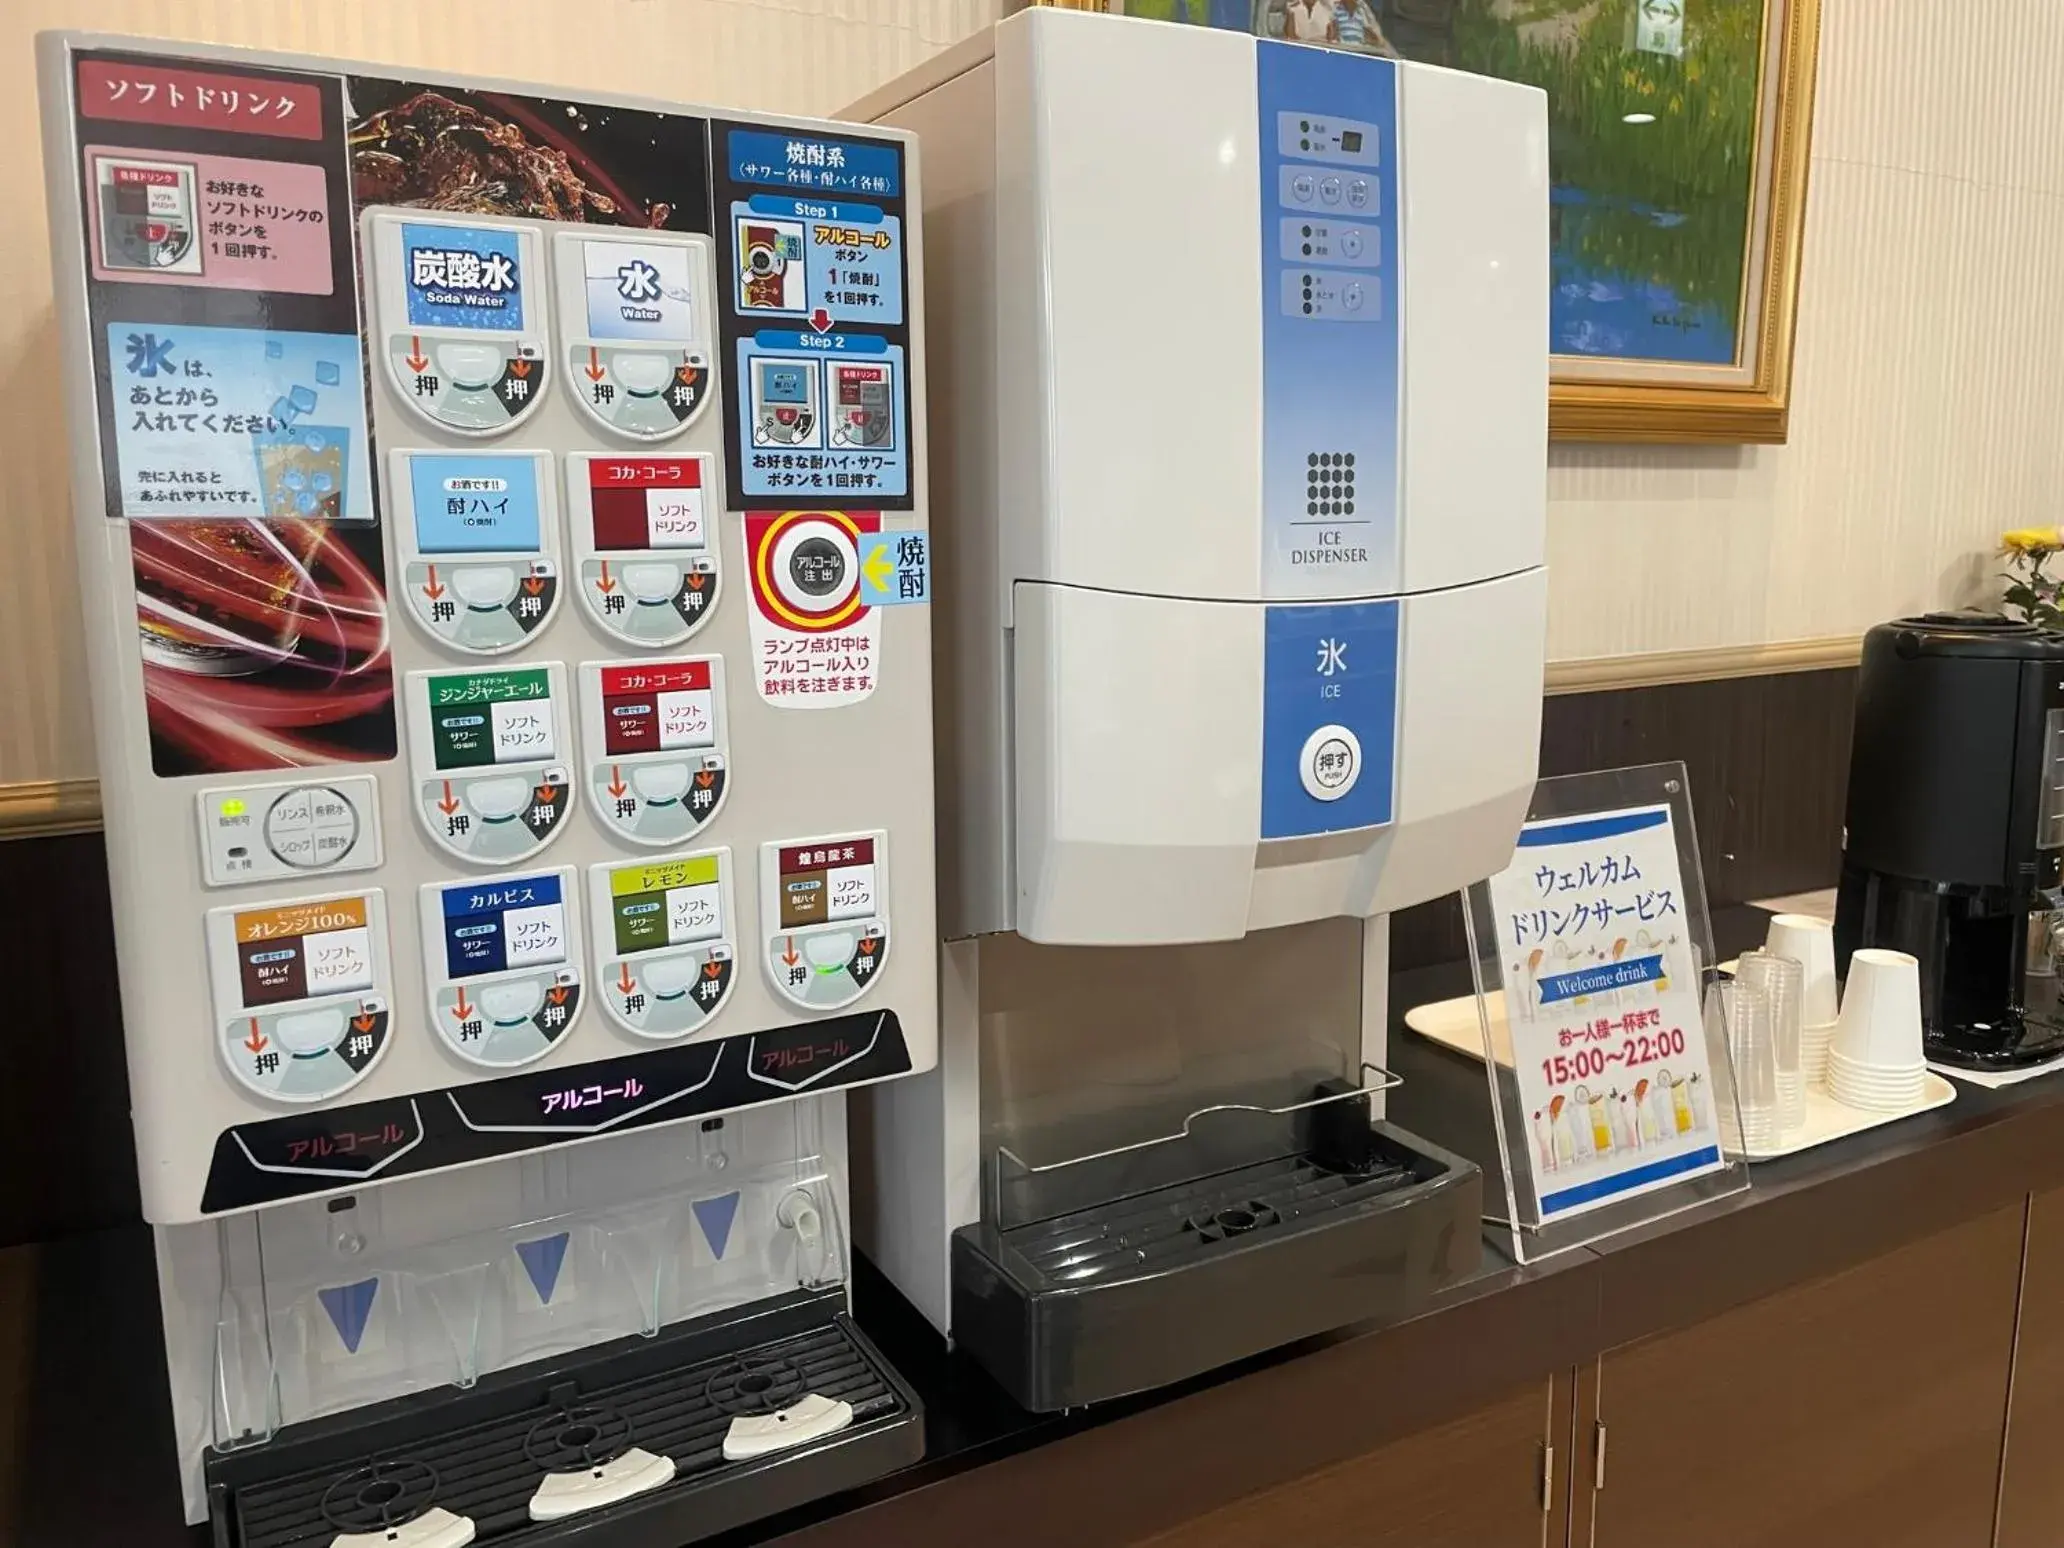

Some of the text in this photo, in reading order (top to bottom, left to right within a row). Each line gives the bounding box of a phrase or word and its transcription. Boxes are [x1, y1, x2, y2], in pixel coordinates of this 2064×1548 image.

[106, 79, 296, 119] ソフトドリンク
[786, 141, 845, 168] 焼酎系
[205, 180, 265, 198] お好きな
[206, 201, 324, 223] ソフトドリンクの
[795, 203, 838, 218] Step 1
[208, 222, 268, 239] ボタンを
[813, 225, 890, 249] アルコール
[835, 249, 868, 262] ボタン
[412, 248, 517, 292] 炭酸水
[619, 261, 658, 300] 水
[426, 291, 505, 308] Soda Water
[621, 307, 661, 321] Water
[800, 335, 845, 348] Step 2
[130, 386, 219, 406] あとから
[415, 376, 439, 397] 押
[505, 379, 528, 400] 押
[593, 384, 615, 404] 押
[674, 386, 695, 406] 押
[131, 411, 296, 436] 入れてください。
[607, 465, 682, 479] コカ・コーラ
[752, 455, 896, 470] お好きな酎ハイ・サワー
[137, 471, 222, 485] 先に入れると
[140, 490, 258, 503] あふれやすいです。
[447, 497, 508, 514] 酎ハイ
[659, 504, 691, 517] ソフト
[654, 521, 698, 533] ドリンク
[1318, 531, 1341, 545] ICE
[796, 556, 840, 569] アルコール
[1291, 548, 1368, 564] DISPENSER
[804, 569, 833, 582] 注出
[896, 536, 925, 599] 焼酎
[520, 598, 541, 617] 押
[604, 596, 625, 615] 押
[683, 592, 703, 611] 押
[432, 603, 455, 622] 押
[763, 636, 870, 655] ランプ点灯中は
[764, 656, 869, 675] アルコール入り
[1316, 638, 1347, 676] 氷
[620, 673, 692, 688] コカ・コーラ
[764, 676, 873, 695] 飲料を注ぎます。
[440, 682, 543, 702] ジンジャーエール
[1320, 685, 1341, 699] ICE
[670, 705, 700, 718] ソフト
[505, 715, 540, 729] ソフト
[620, 720, 646, 729] サワー
[665, 721, 706, 733] ドリンク
[450, 731, 480, 742] サワー
[501, 731, 546, 746] ドリンク
[1319, 751, 1348, 771] 押す
[1324, 771, 1343, 780] PUSH
[616, 799, 636, 818] 押
[692, 790, 712, 809] 押
[278, 808, 309, 820] リンス
[532, 805, 554, 825] 押
[447, 816, 470, 836] 押
[642, 872, 688, 888] レモン
[837, 880, 864, 892] ソフト
[1535, 854, 1641, 899] ウェルカム
[678, 899, 709, 913] ソフト
[833, 893, 870, 907] ドリンク
[247, 913, 356, 938] オレンジ100%
[629, 918, 656, 928] サワー
[674, 914, 715, 929] ドリンク
[1511, 888, 1677, 946] ドリンクサービス
[517, 921, 550, 936] ソフト
[318, 946, 356, 961] ソフト
[462, 940, 491, 951] サワー
[513, 936, 558, 952] ドリンク
[313, 960, 363, 979] ドリンク
[789, 966, 807, 985] 押
[856, 957, 874, 975] 押
[1557, 962, 1648, 996] Welcome drink
[700, 981, 720, 1000] 押
[625, 995, 645, 1014] 押
[544, 1007, 566, 1027] 押
[460, 1021, 481, 1041] 押
[1558, 1008, 1661, 1048] お一人様一杯まで
[350, 1034, 374, 1058] 押
[762, 1038, 849, 1070] アルコール
[255, 1052, 280, 1075] 押
[541, 1078, 643, 1114] アルコール
[287, 1124, 404, 1160] アルコール
